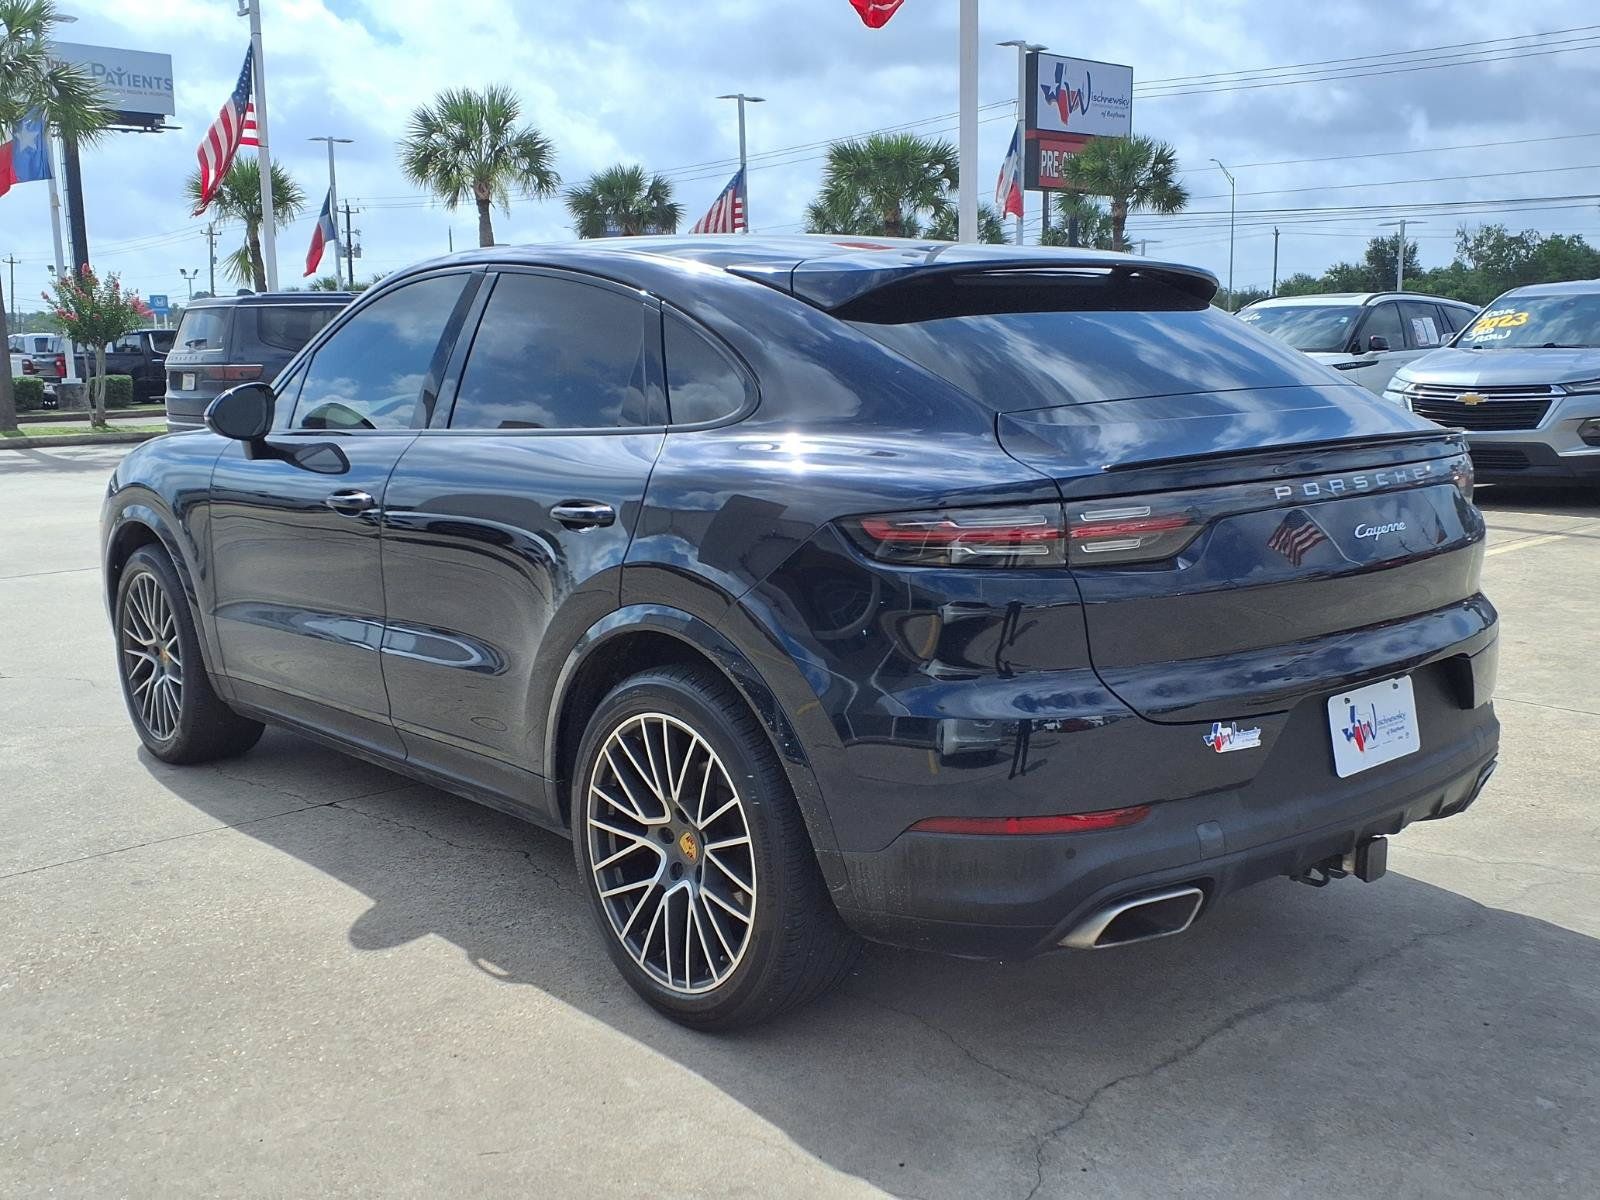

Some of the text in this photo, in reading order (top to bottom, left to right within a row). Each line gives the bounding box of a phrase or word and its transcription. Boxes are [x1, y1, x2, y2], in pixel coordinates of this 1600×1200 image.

[1472, 312, 1529, 335] 2023
[1274, 466, 1426, 500] PORSCHE
[1354, 520, 1408, 541] Cayenne
